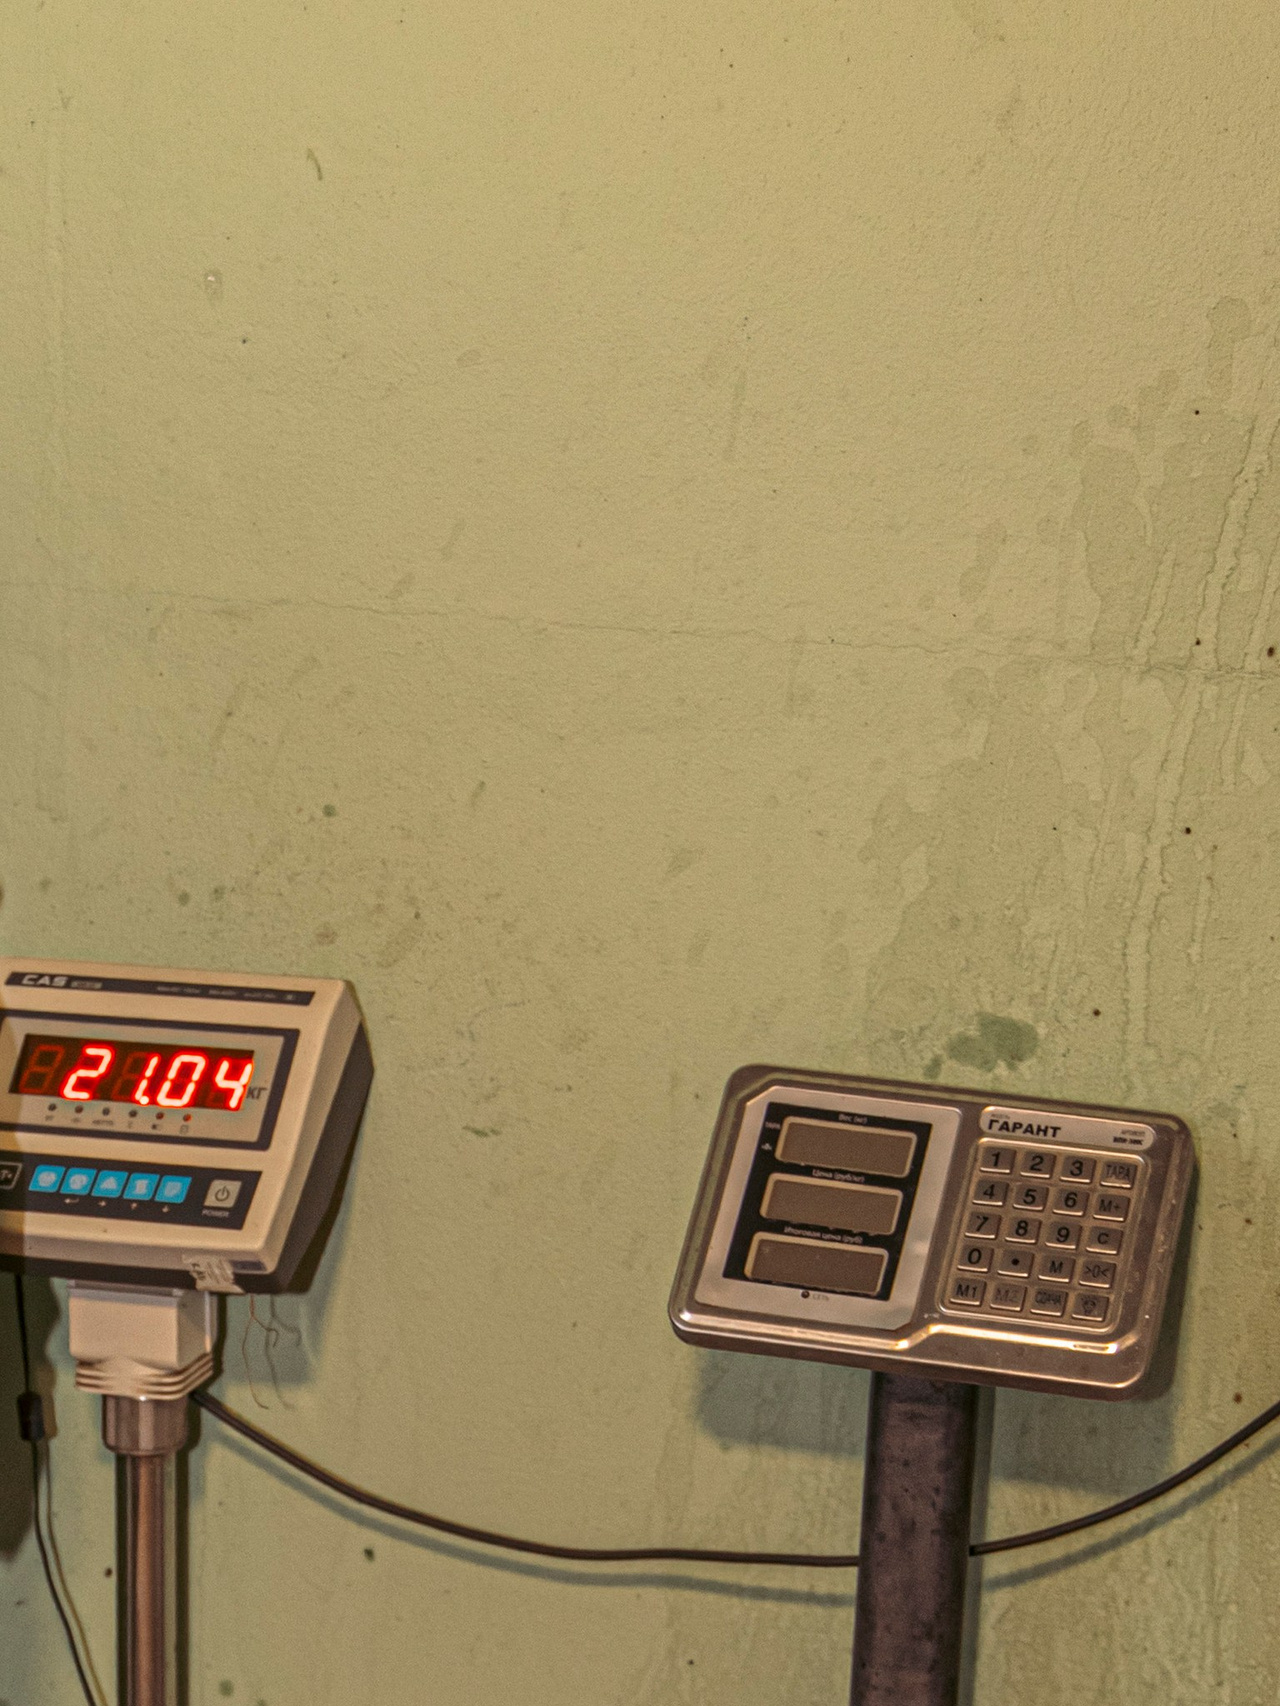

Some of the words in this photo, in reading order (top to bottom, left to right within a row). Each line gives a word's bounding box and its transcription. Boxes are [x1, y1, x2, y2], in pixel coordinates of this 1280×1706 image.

[22, 974, 68, 987] CAS
[62, 1045, 253, 1110] 21.04
[988, 1119, 1061, 1138] ГАРАНТ
[991, 1152, 1000, 1167] 1
[1030, 1155, 1044, 1171] 2
[1070, 1160, 1083, 1176] 3
[983, 1183, 996, 1200] 4
[1023, 1188, 1037, 1205] 5
[1064, 1192, 1077, 1208] 6
[976, 1215, 989, 1232] 7
[1015, 1220, 1029, 1236] 8
[1057, 1226, 1070, 1243] 9
[967, 1248, 981, 1265] 0
